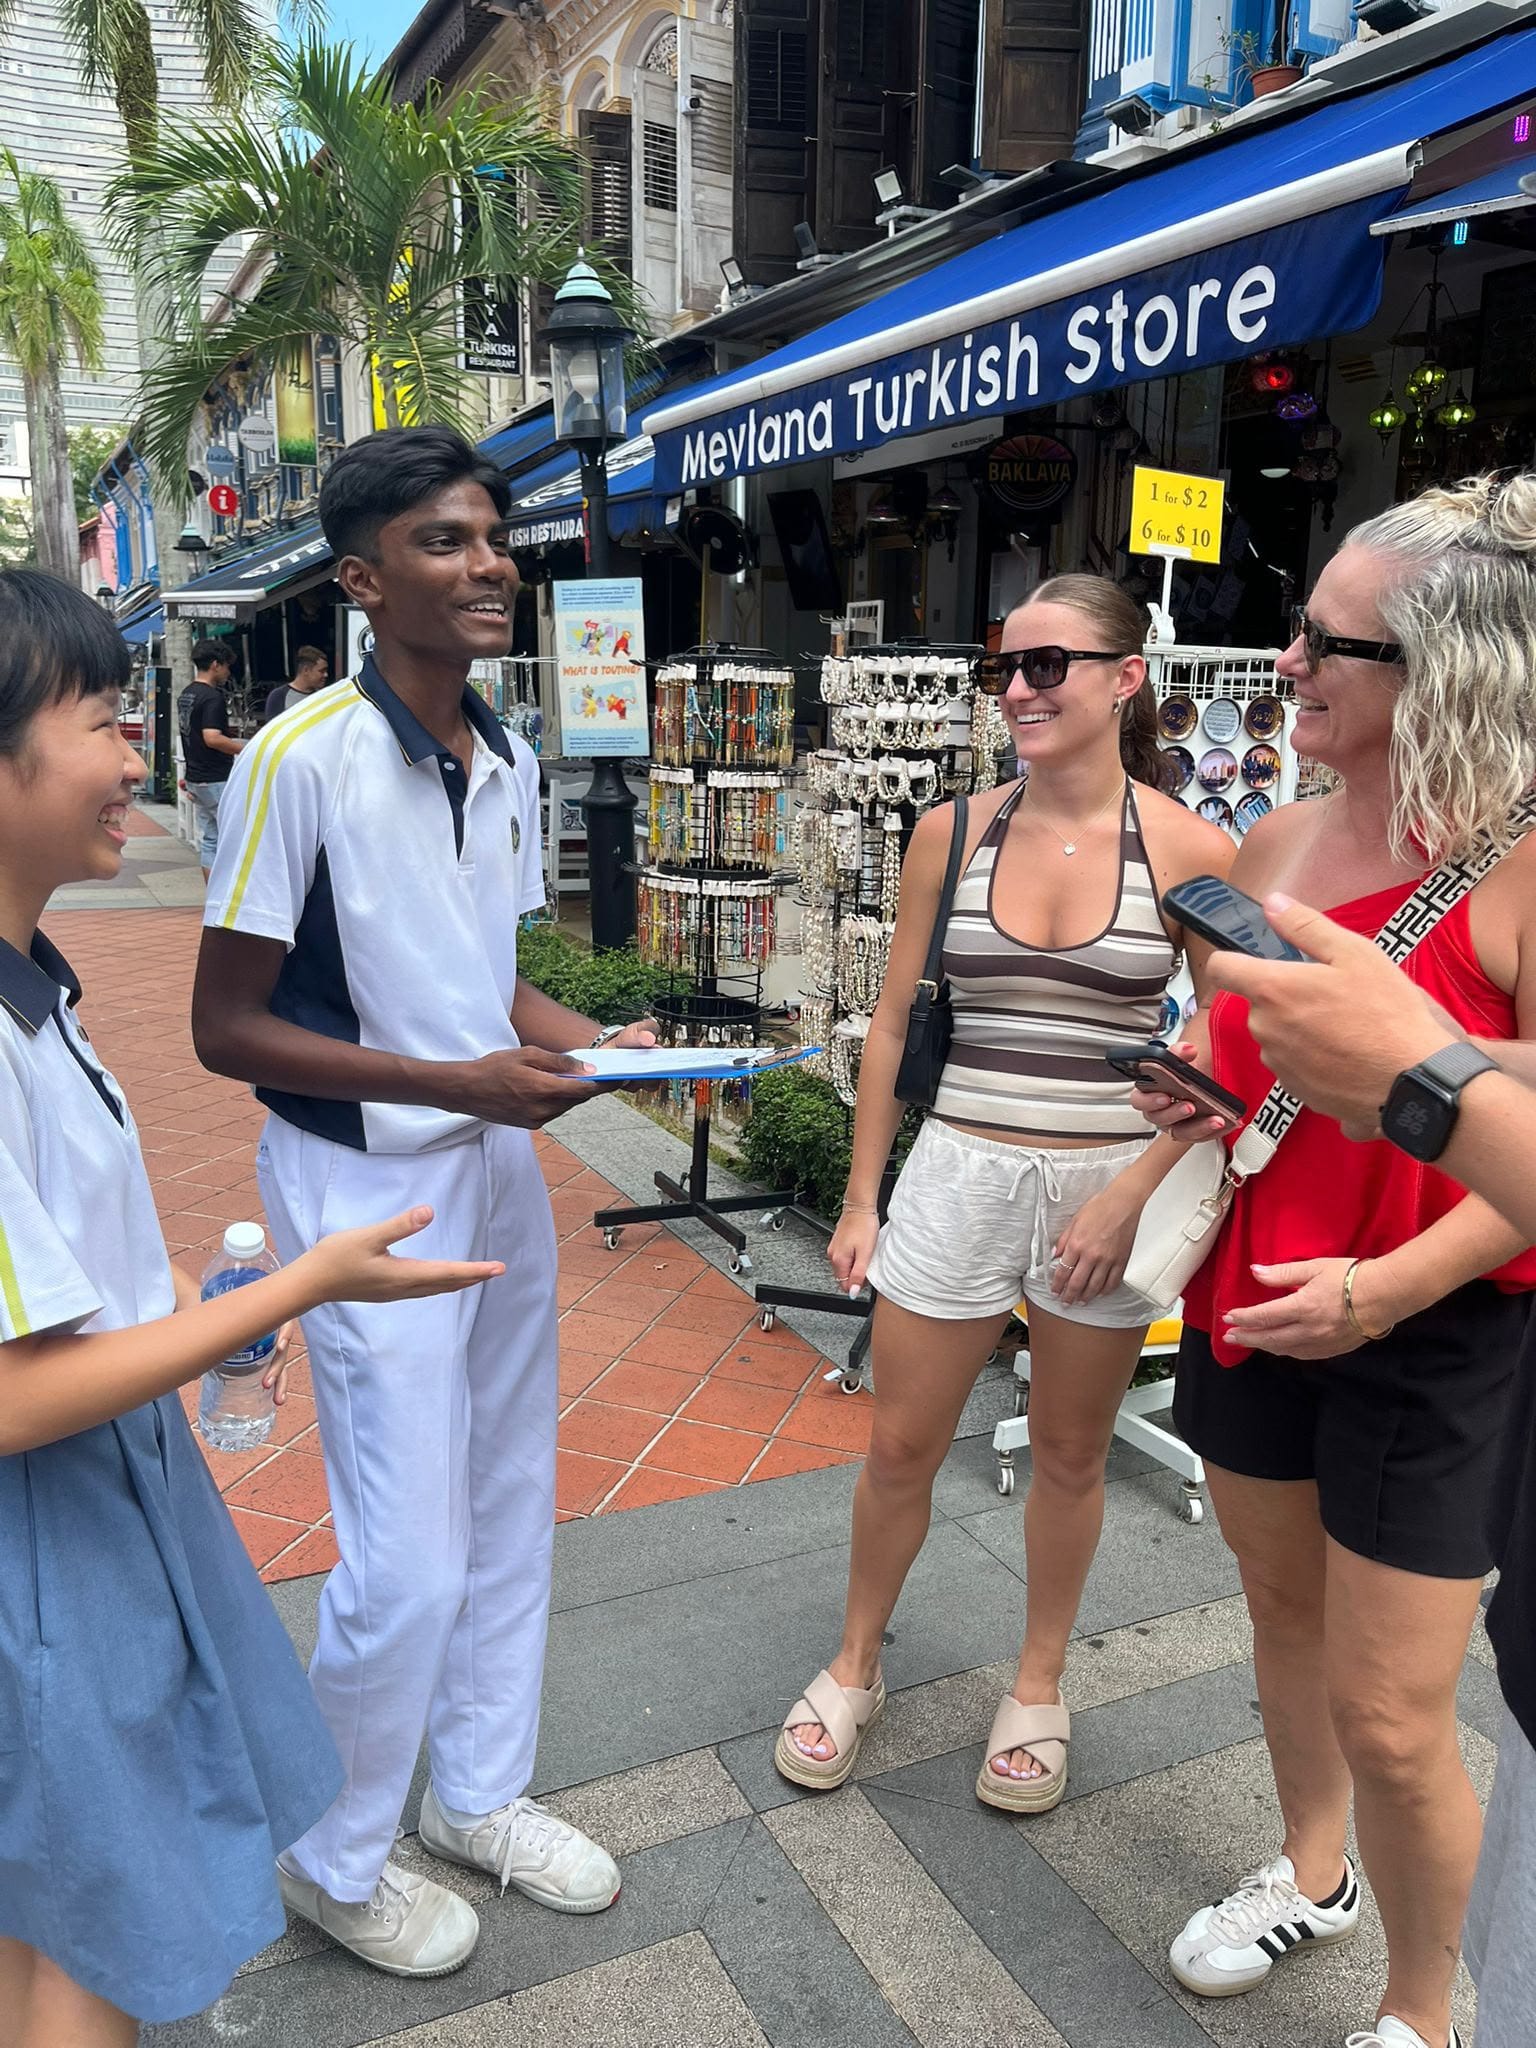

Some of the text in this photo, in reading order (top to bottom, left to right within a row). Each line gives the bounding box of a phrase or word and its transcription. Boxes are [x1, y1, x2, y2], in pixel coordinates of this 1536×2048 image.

[469, 341, 516, 358] TURKISH
[681, 399, 833, 484] Mevlana
[848, 321, 1039, 441] Turkish
[1064, 265, 1276, 384] Store
[989, 462, 1071, 482] BAKLAVA
[1150, 482, 1159, 501] 1
[1164, 491, 1178, 504] for
[509, 517, 585, 548] KISH RESTAURA
[1142, 519, 1153, 540] 6
[1157, 530, 1171, 542] for
[563, 664, 641, 677] WHAT IS TOUTING?
